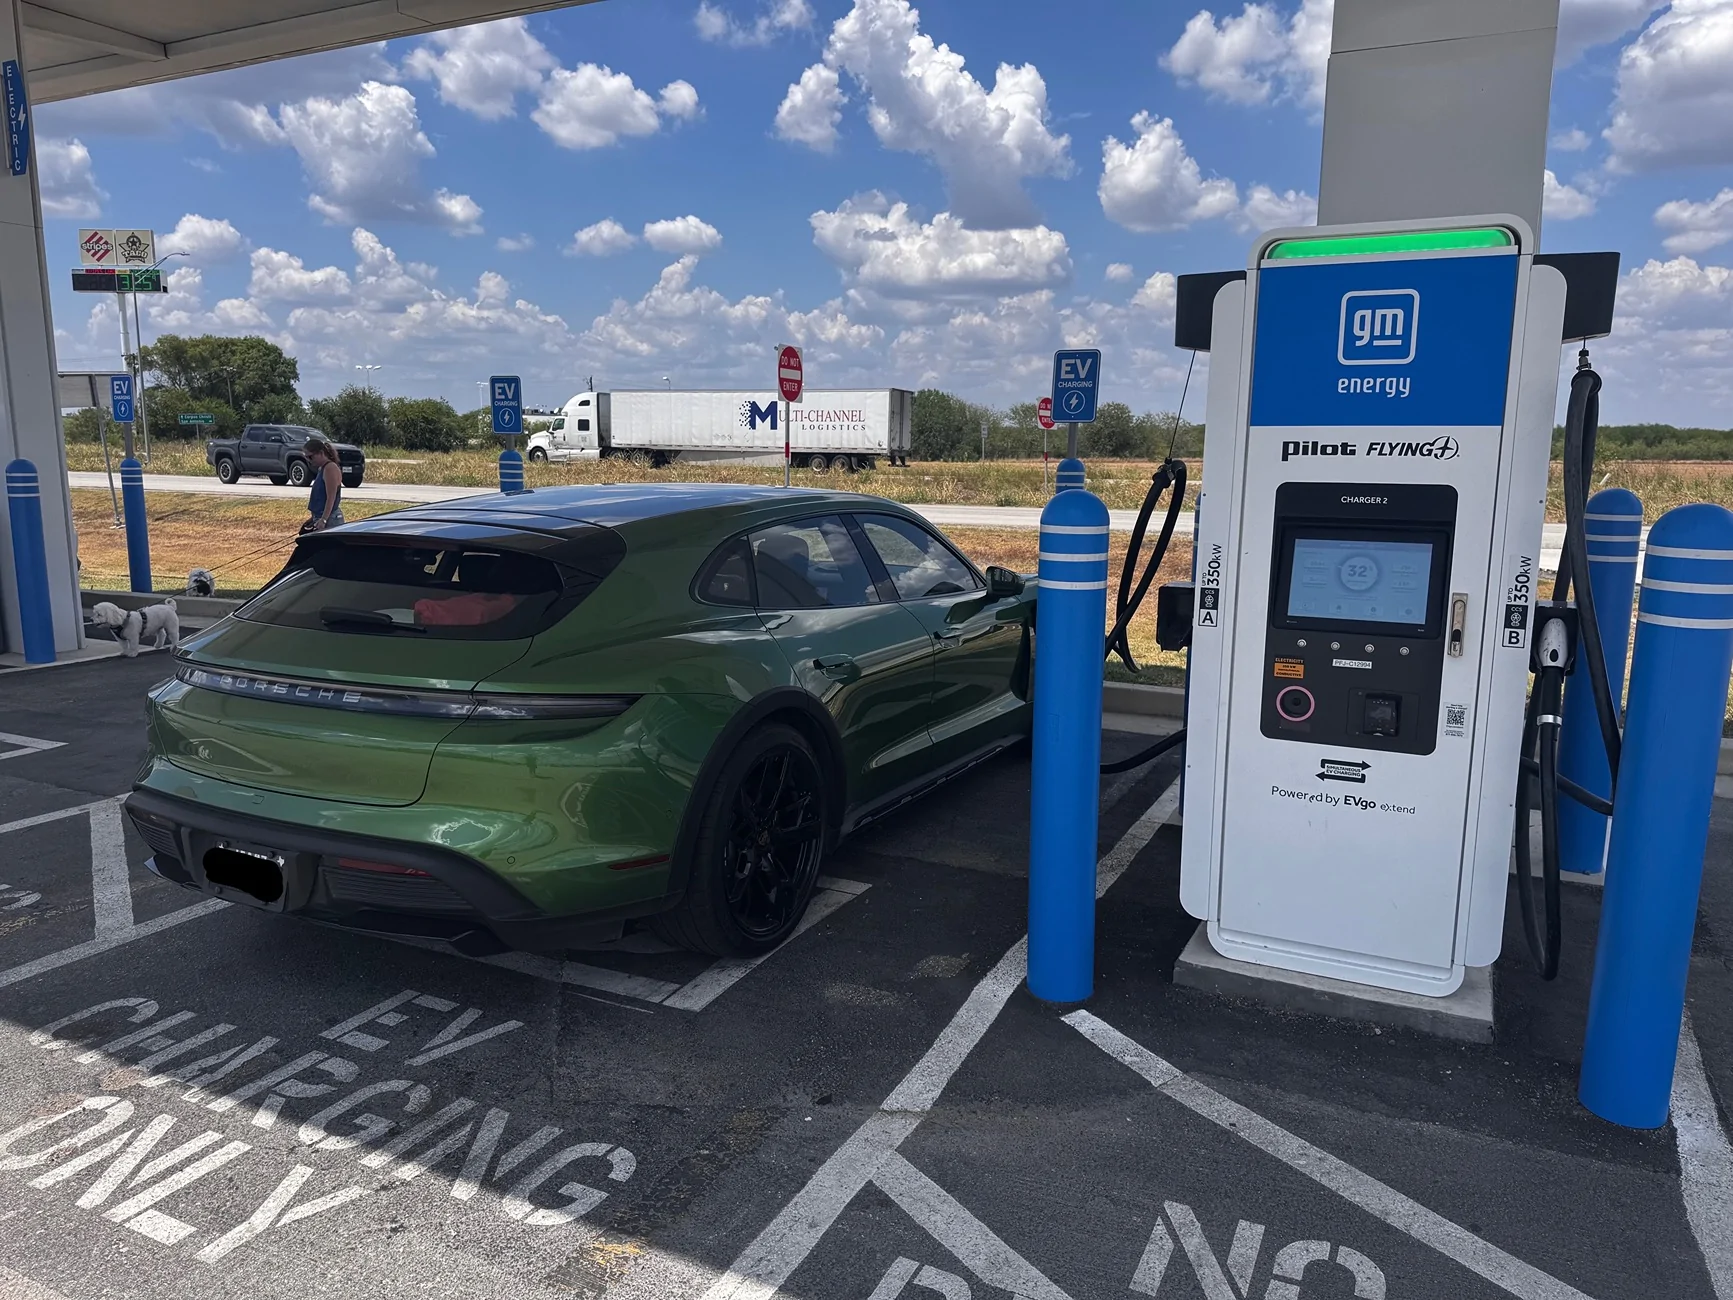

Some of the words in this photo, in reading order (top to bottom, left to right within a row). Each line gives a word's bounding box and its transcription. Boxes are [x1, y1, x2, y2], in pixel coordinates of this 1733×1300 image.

[6, 65, 21, 171] ELECTRIC
[81, 242, 114, 252] stripes
[122, 250, 148, 258] TACO
[1353, 308, 1404, 346] gm
[781, 356, 788, 365] DO
[790, 358, 799, 367] NOT
[1060, 358, 1093, 379] EV
[113, 381, 128, 394] EV
[494, 383, 516, 399] EV
[783, 381, 799, 392] ENTER
[1337, 377, 1411, 398] energy
[1281, 440, 1357, 461] pilot
[1340, 496, 1381, 504] CHARGER
[1207, 544, 1222, 587] 350kW
[1514, 556, 1532, 603] 350kW
[1202, 611, 1214, 624] A
[1508, 631, 1520, 645] B
[220, 675, 363, 703] PORSCHE
[1271, 786, 1322, 803] Powered
[1326, 793, 1340, 806] by
[1344, 795, 1376, 810] EVgo
[318, 989, 525, 1067] EV
[29, 997, 637, 1227] CHARGING
[0, 1096, 374, 1265] ONLY
